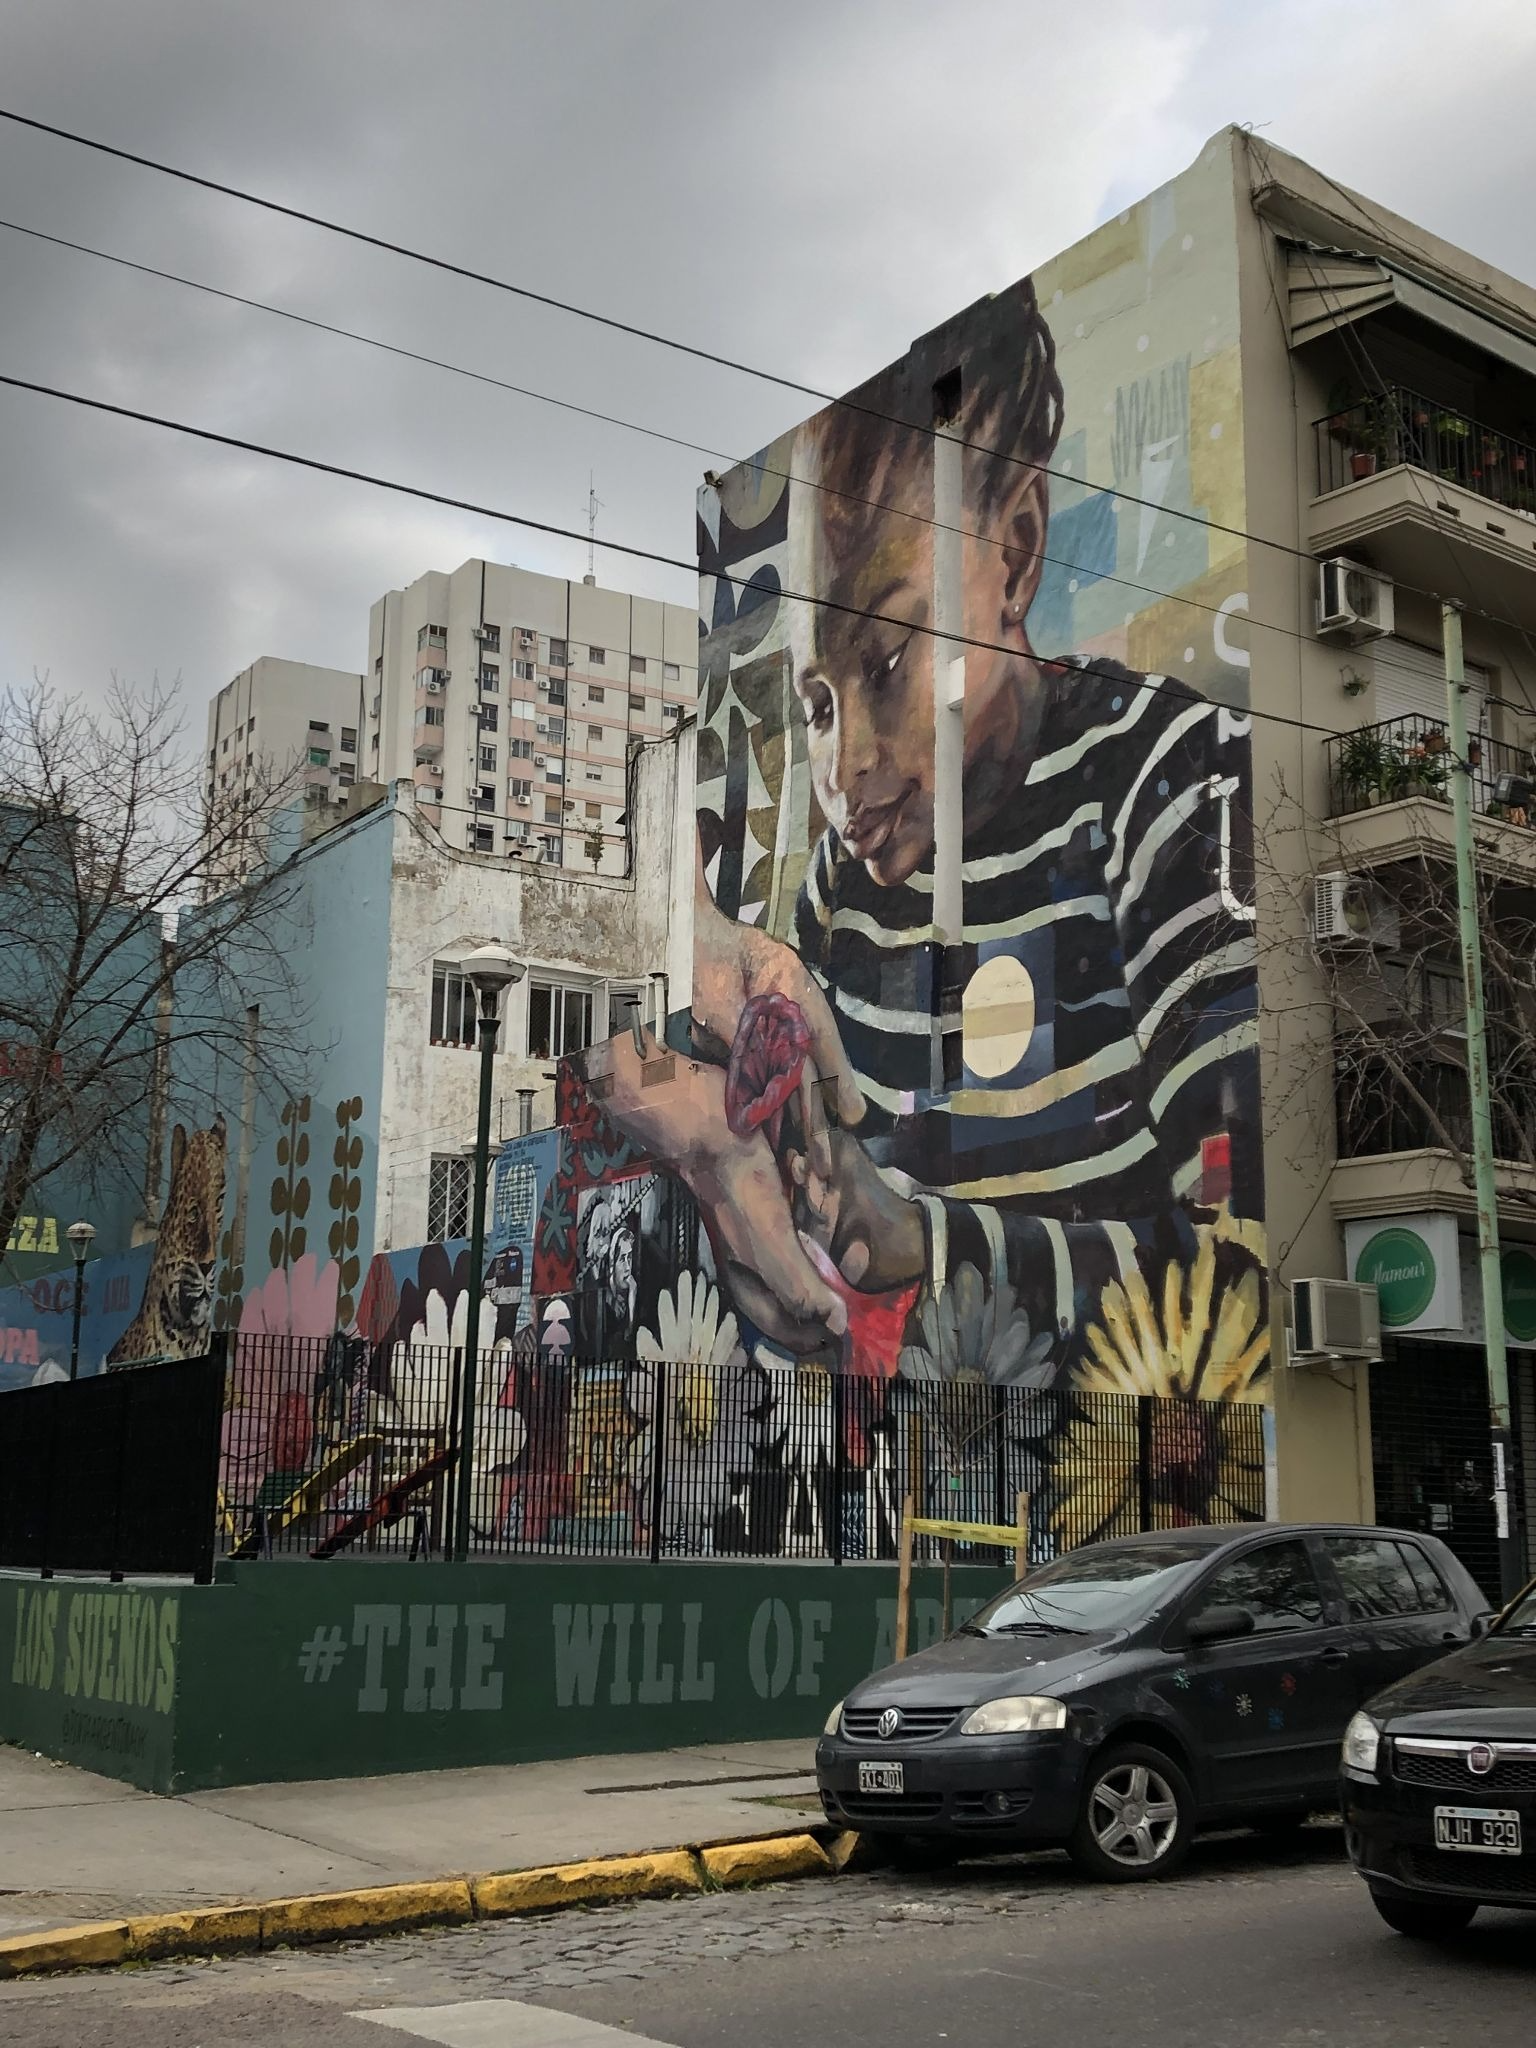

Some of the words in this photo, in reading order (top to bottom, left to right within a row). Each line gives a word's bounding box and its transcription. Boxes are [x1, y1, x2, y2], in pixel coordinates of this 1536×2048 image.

[12, 1588, 59, 1691] LOS
[551, 1601, 716, 1708] WILL
[748, 1597, 833, 1700] OF
[860, 1770, 878, 1788] FKI
[883, 1771, 901, 1789] 401
[1439, 1818, 1472, 1843] NJH
[1483, 1821, 1517, 1846] 929
